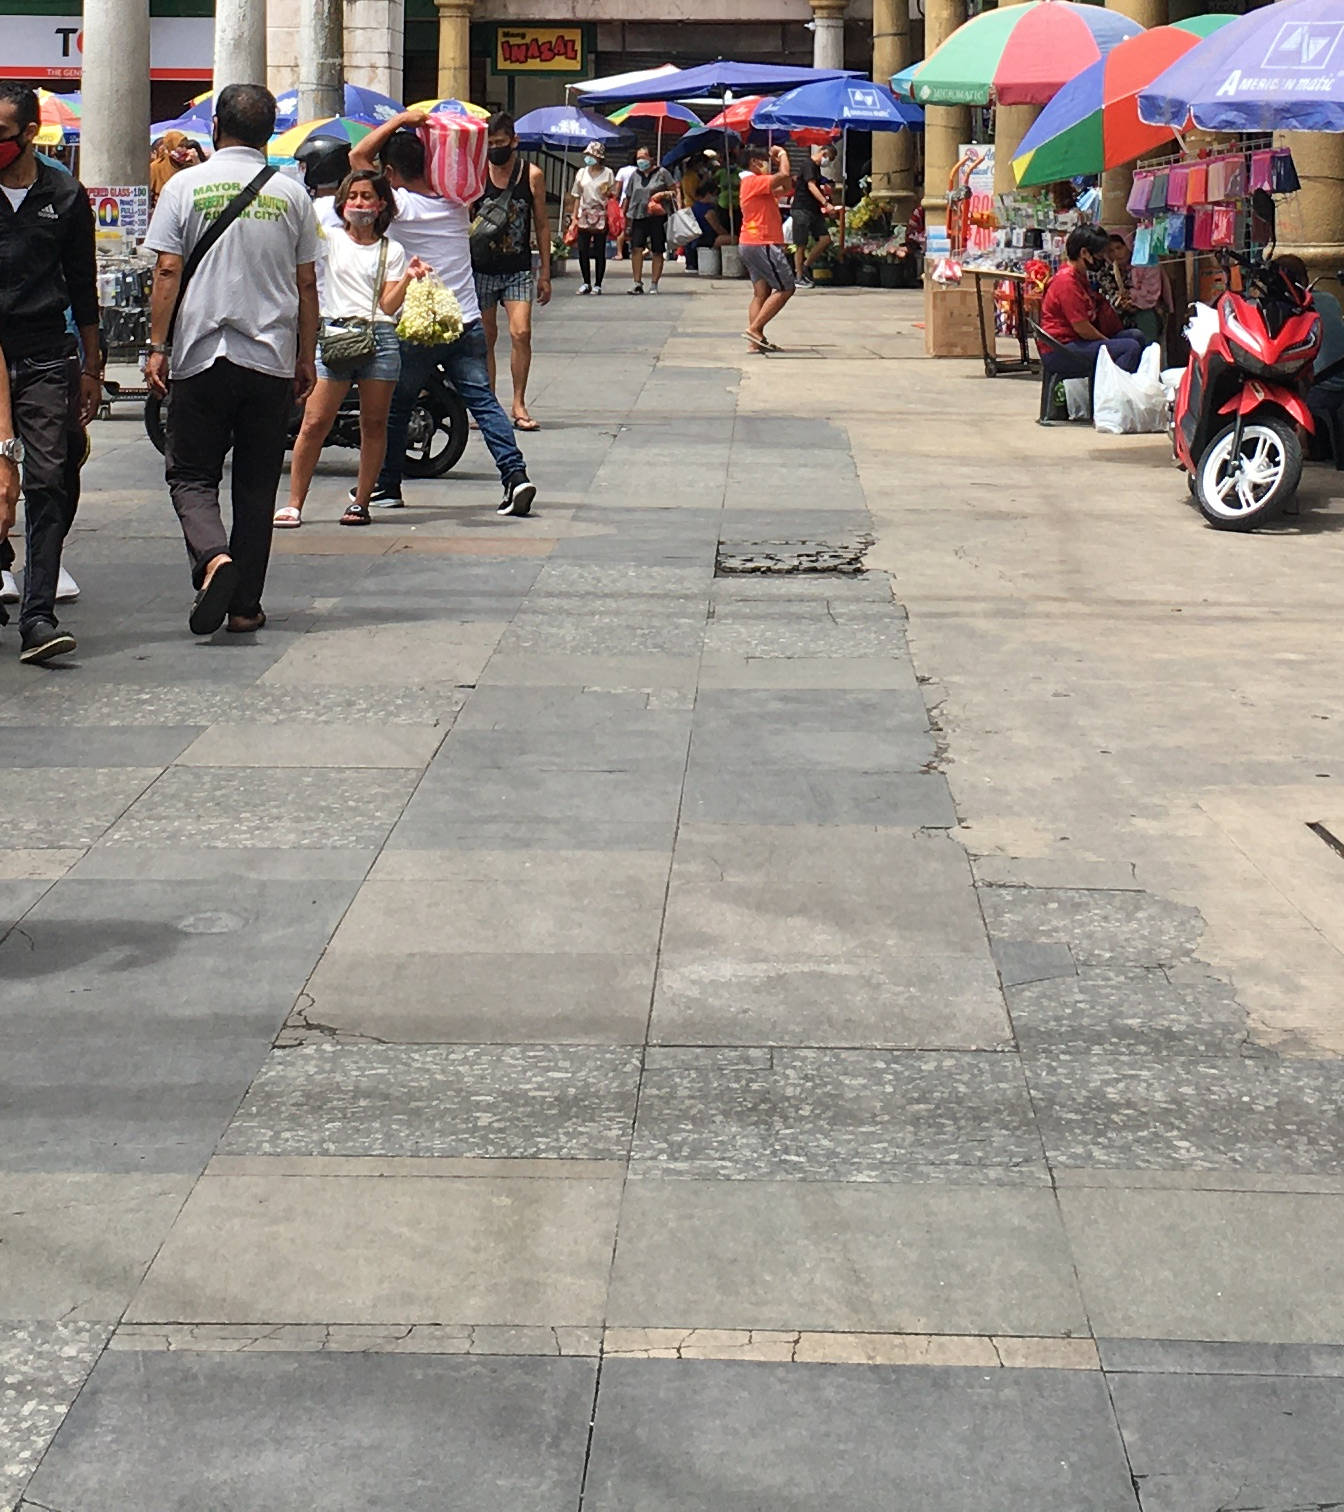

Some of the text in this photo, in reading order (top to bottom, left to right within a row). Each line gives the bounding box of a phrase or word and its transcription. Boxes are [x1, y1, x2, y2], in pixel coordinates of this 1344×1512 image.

[501, 35, 577, 64] INASAL
[193, 182, 241, 196] MAYOR
[254, 210, 280, 222] CITY
